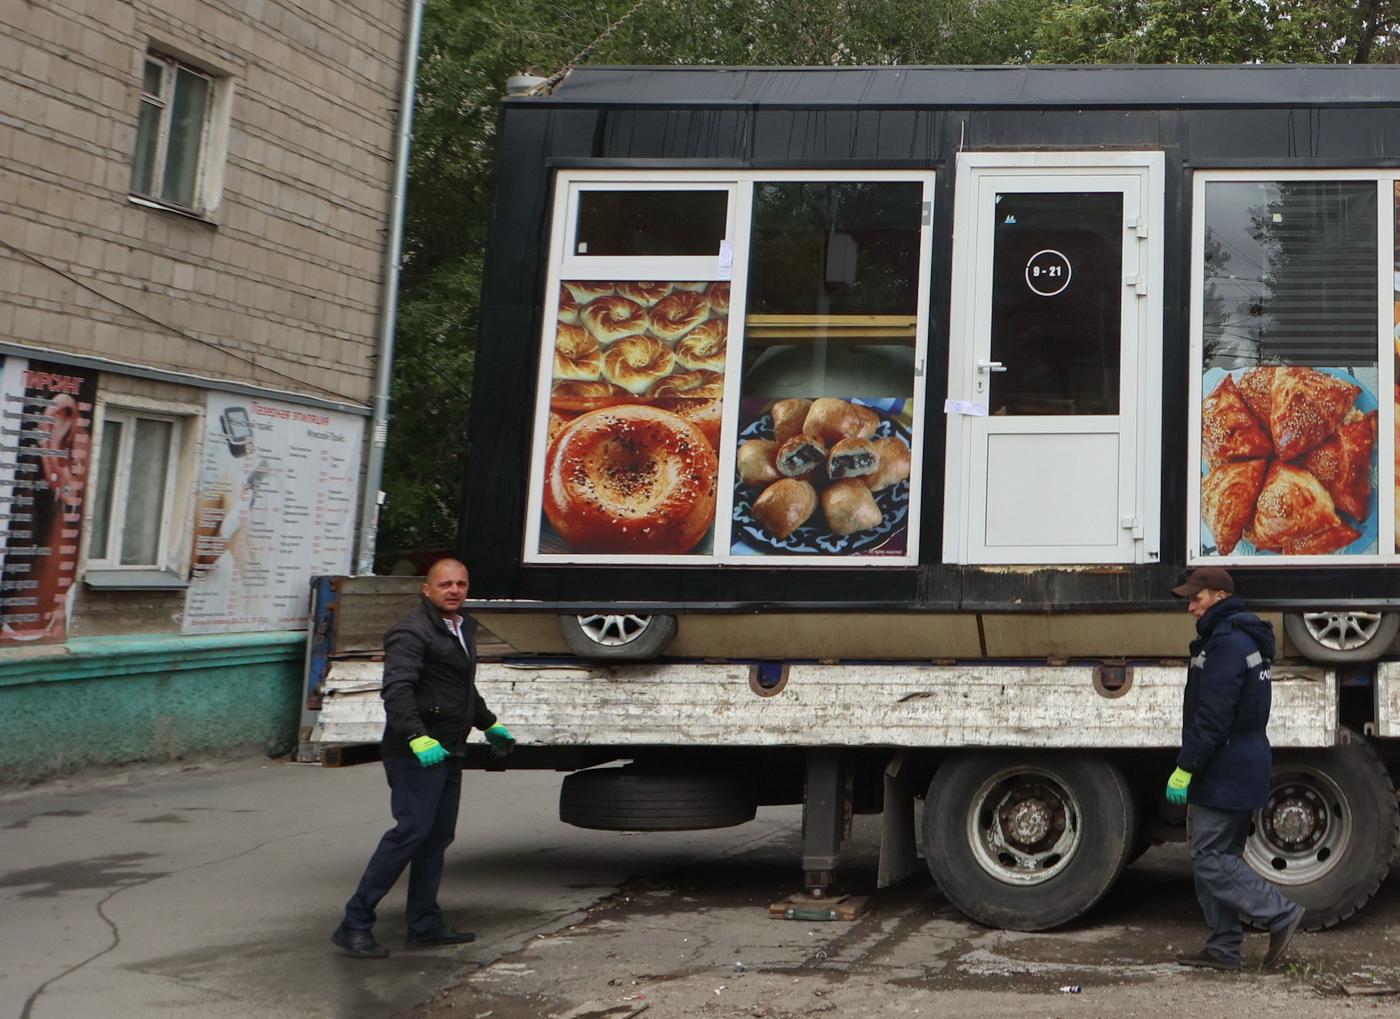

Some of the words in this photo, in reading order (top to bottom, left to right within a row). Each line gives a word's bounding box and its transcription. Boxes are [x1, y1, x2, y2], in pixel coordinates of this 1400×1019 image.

[1033, 265, 1040, 277] 9
[1049, 265, 1062, 277] 21
[22, 369, 85, 395] ПИРСИНГ
